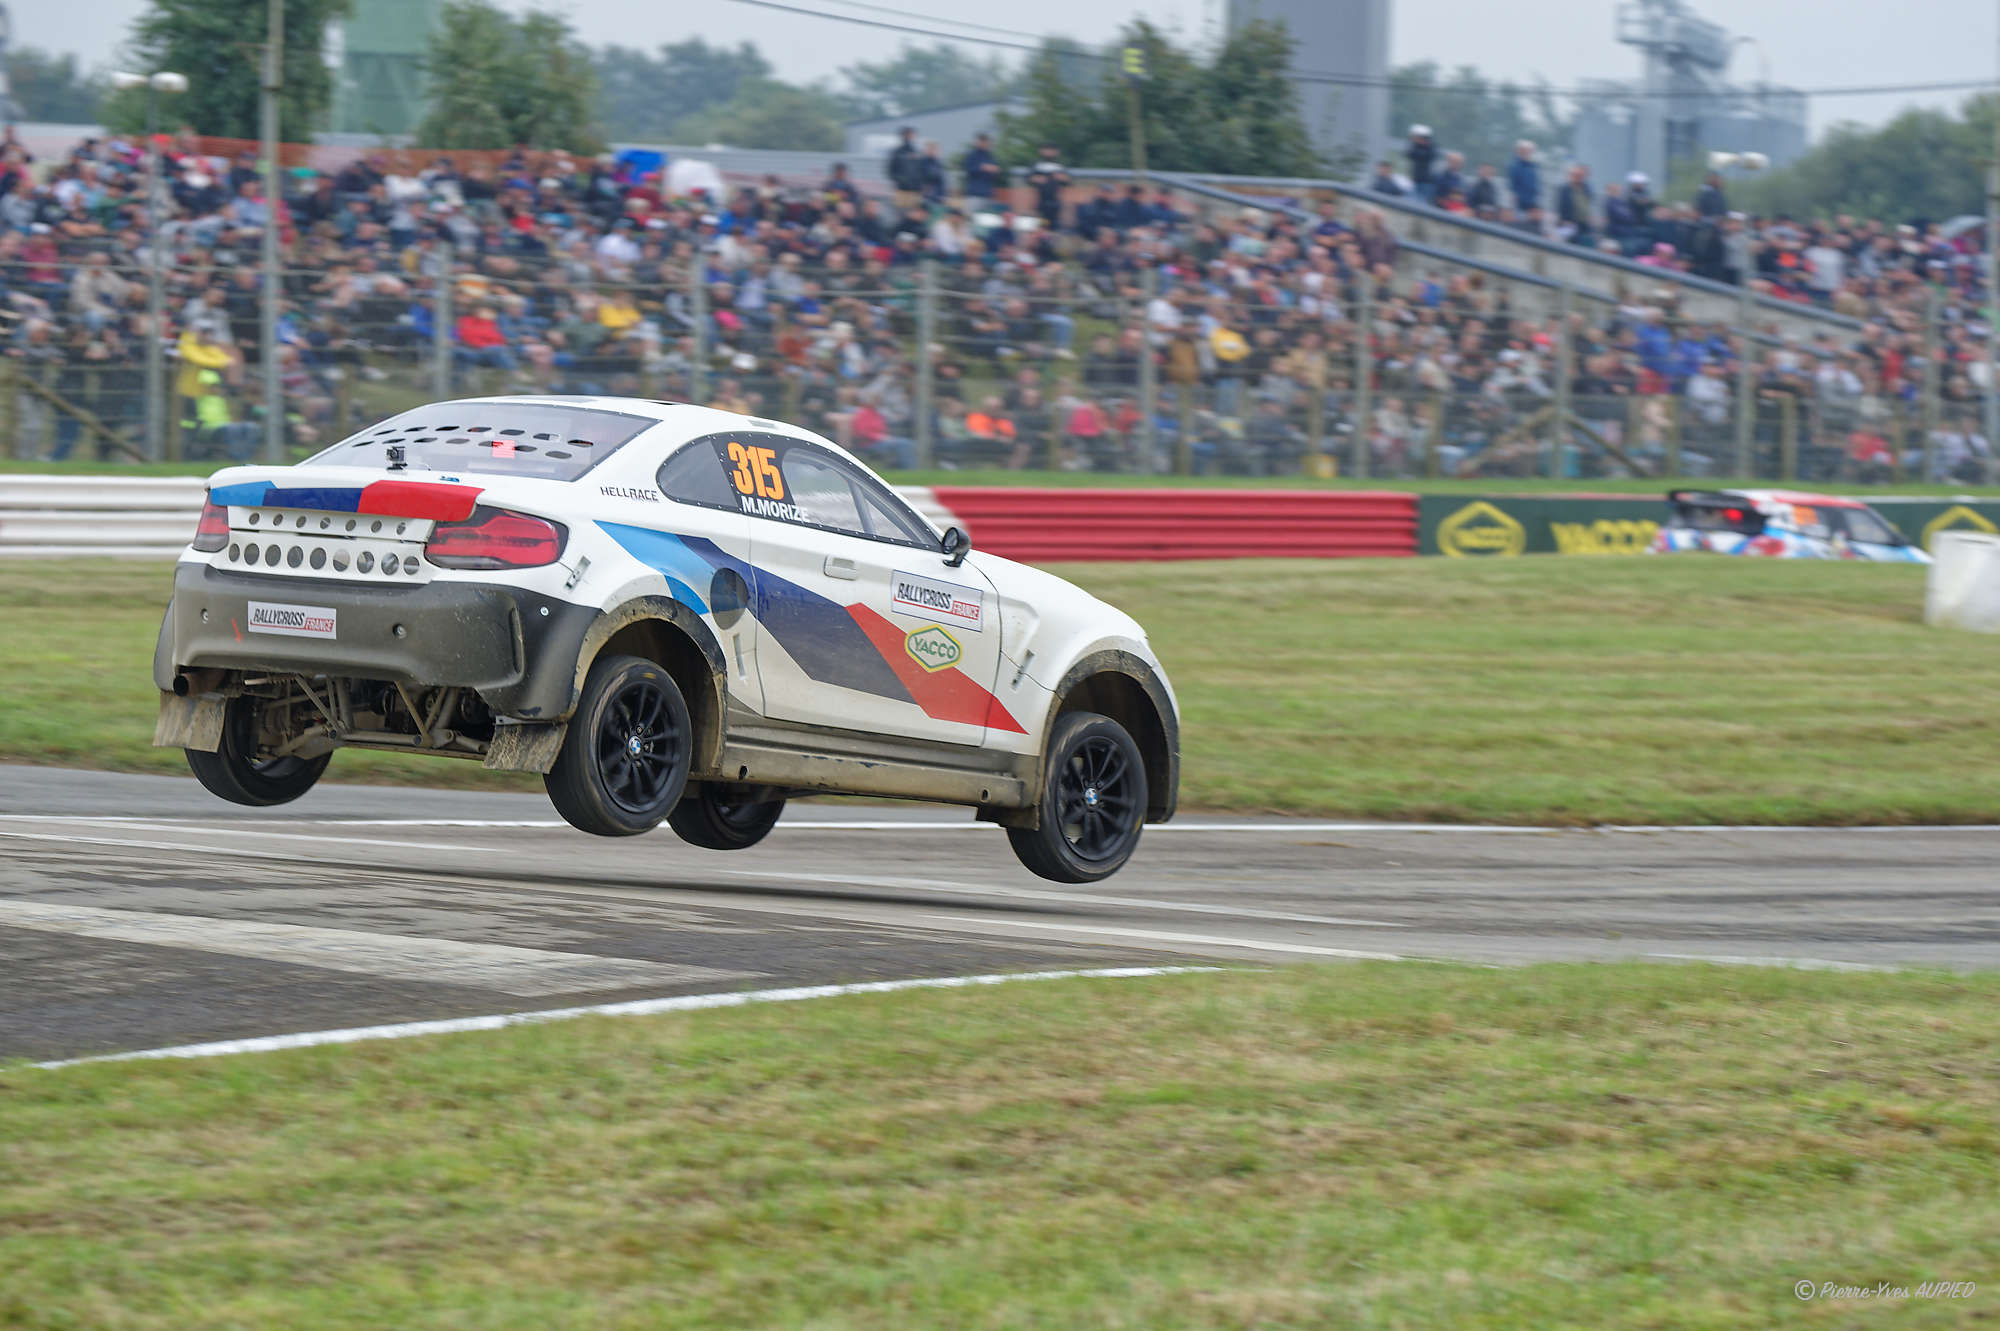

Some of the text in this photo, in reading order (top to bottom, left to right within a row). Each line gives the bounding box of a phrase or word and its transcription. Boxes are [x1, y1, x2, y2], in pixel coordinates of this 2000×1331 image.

[727, 442, 784, 500] 315
[600, 486, 659, 501] HELLRACE
[741, 496, 810, 523] M.MORIZE
[897, 582, 952, 609] RALLYCROSS
[253, 607, 305, 626] RALLYCROSS
[913, 636, 956, 659] YACCO
